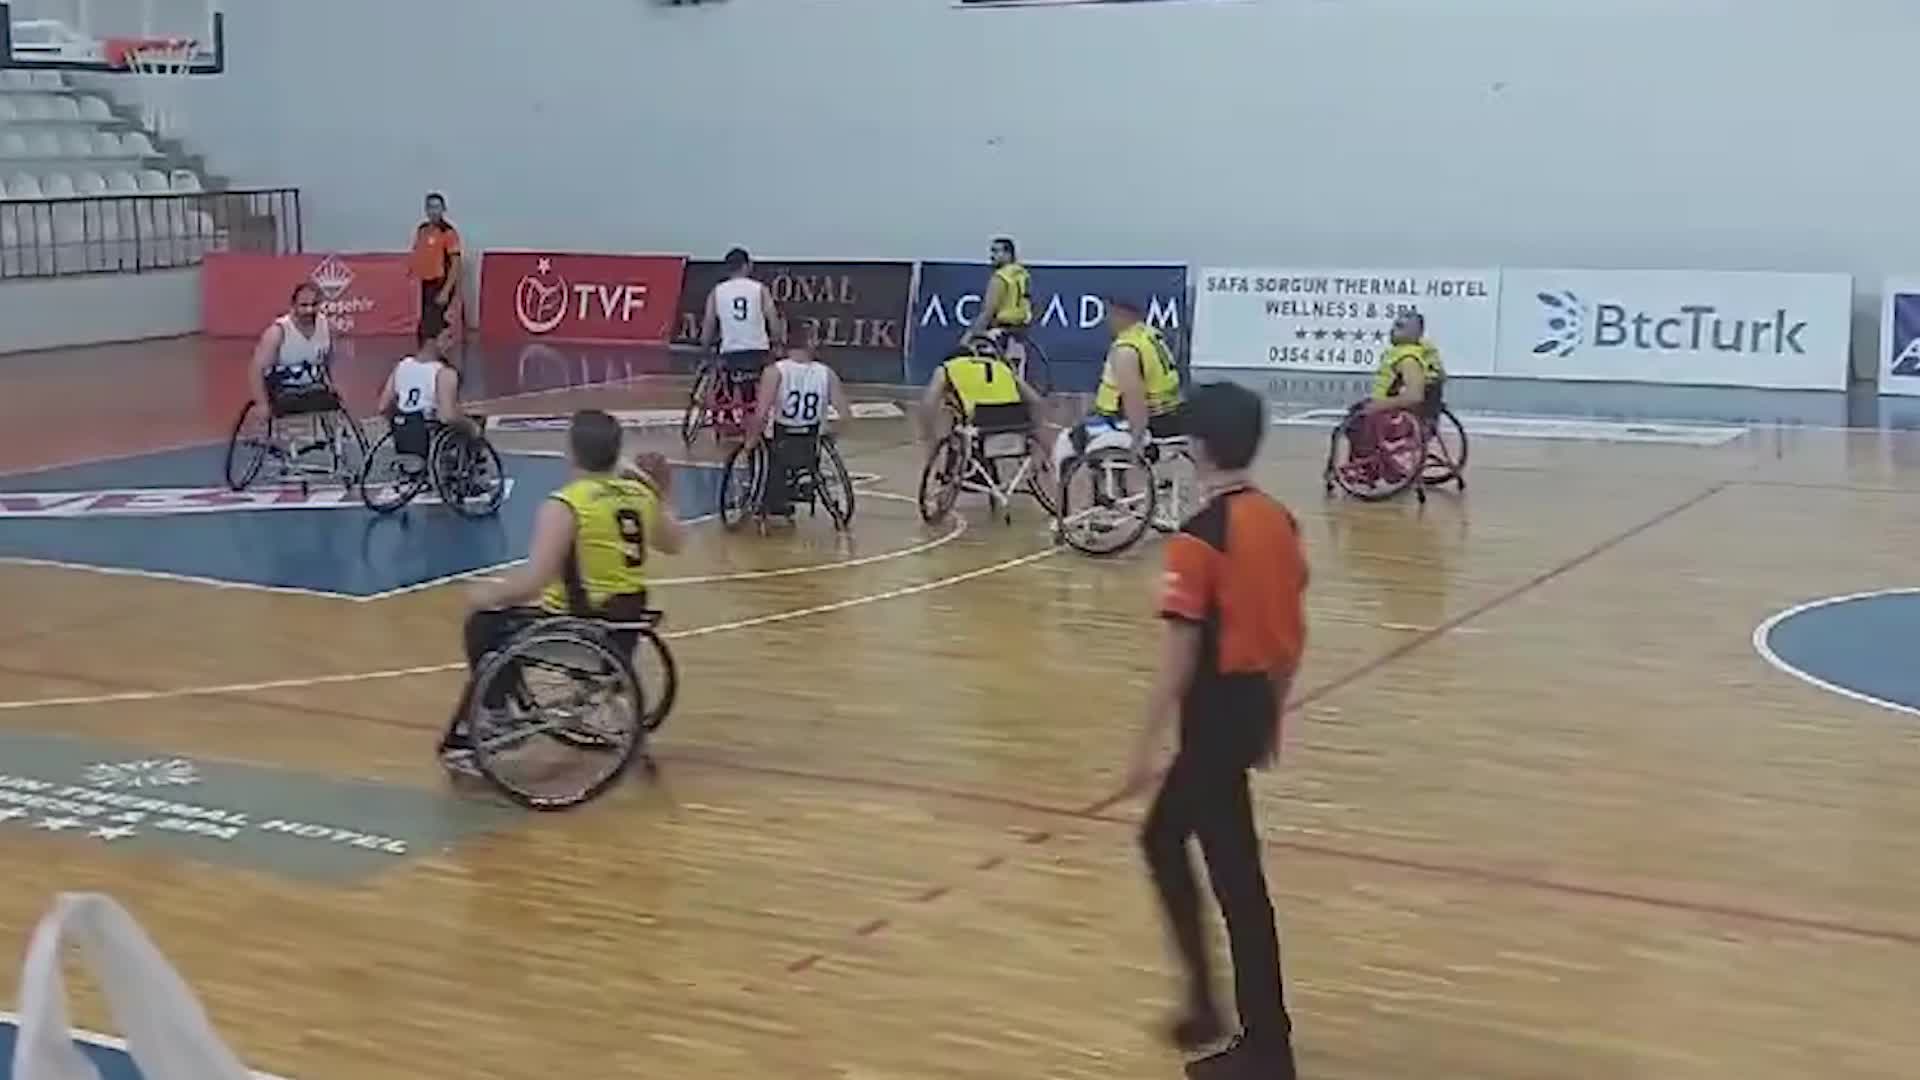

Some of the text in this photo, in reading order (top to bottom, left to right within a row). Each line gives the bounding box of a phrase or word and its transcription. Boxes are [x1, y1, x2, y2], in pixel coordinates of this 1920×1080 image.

[574, 284, 646, 321] TVF
[1207, 277, 1487, 297] SAFA SORGUN THERMAL HOTEL
[733, 297, 747, 320] 9
[921, 294, 1179, 329] ACADM
[1265, 300, 1358, 319] WELLNESS
[1594, 304, 1808, 354] BtcTurk
[782, 391, 819, 420] 38
[616, 509, 644, 568] 9
[259, 819, 407, 854] HOTEL
